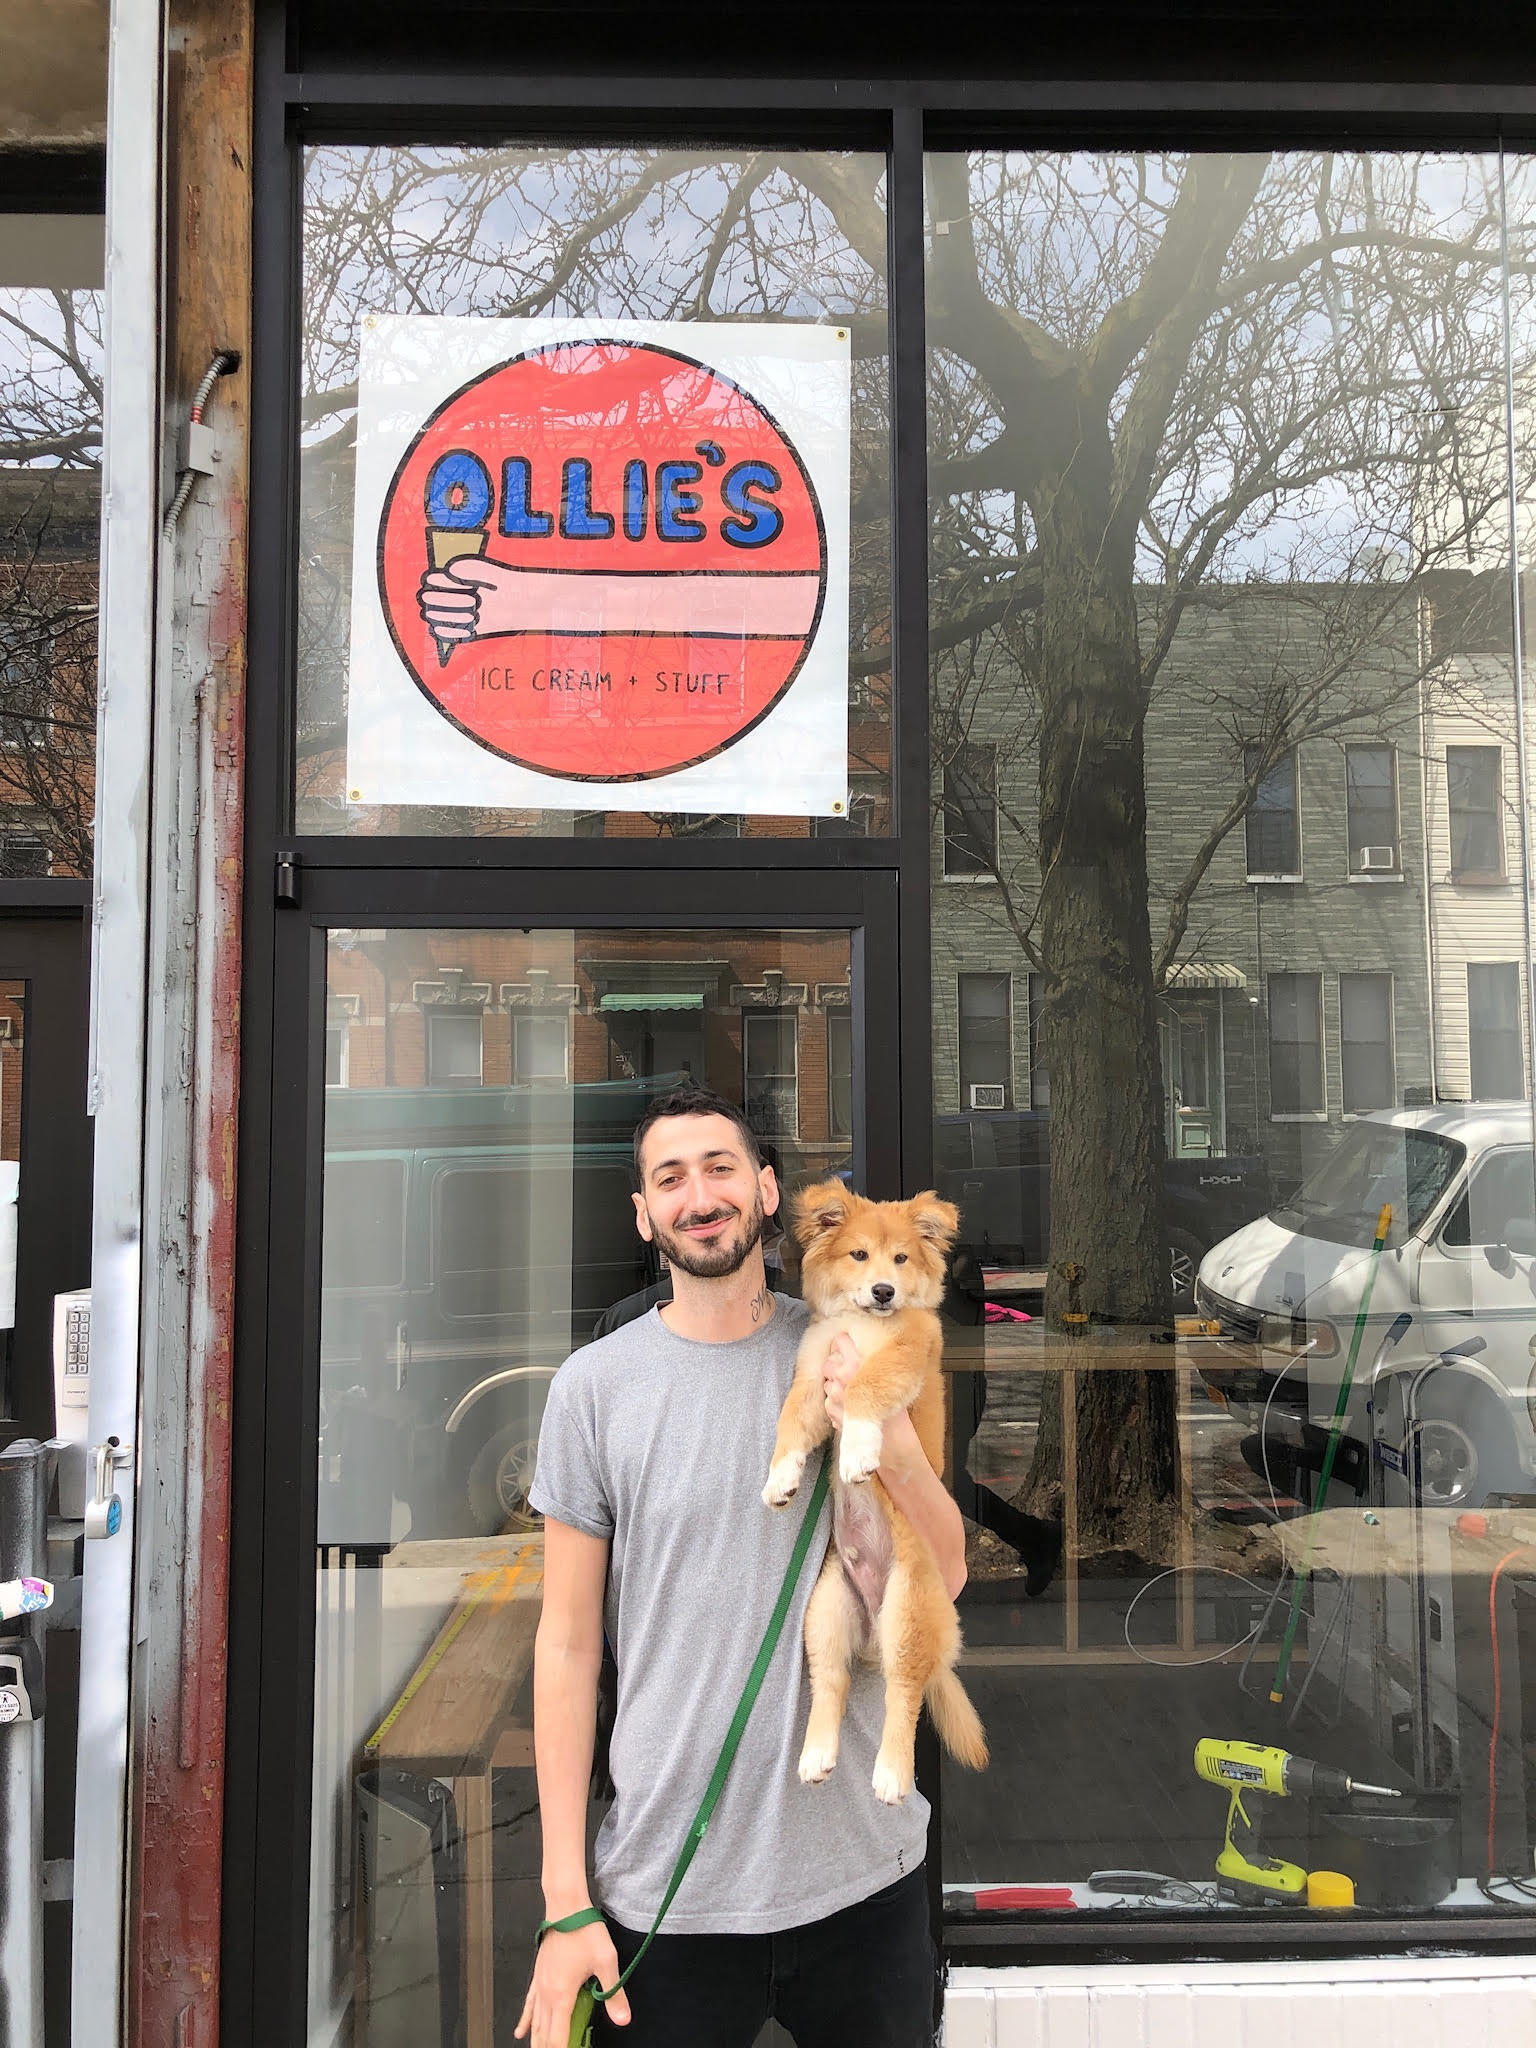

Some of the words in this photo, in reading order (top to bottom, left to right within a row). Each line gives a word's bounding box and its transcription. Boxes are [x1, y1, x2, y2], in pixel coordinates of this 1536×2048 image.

[425, 440, 784, 549] OLLIE'S
[480, 667, 516, 691] ICE
[531, 668, 613, 692] CREAM
[655, 671, 730, 695] STUFF
